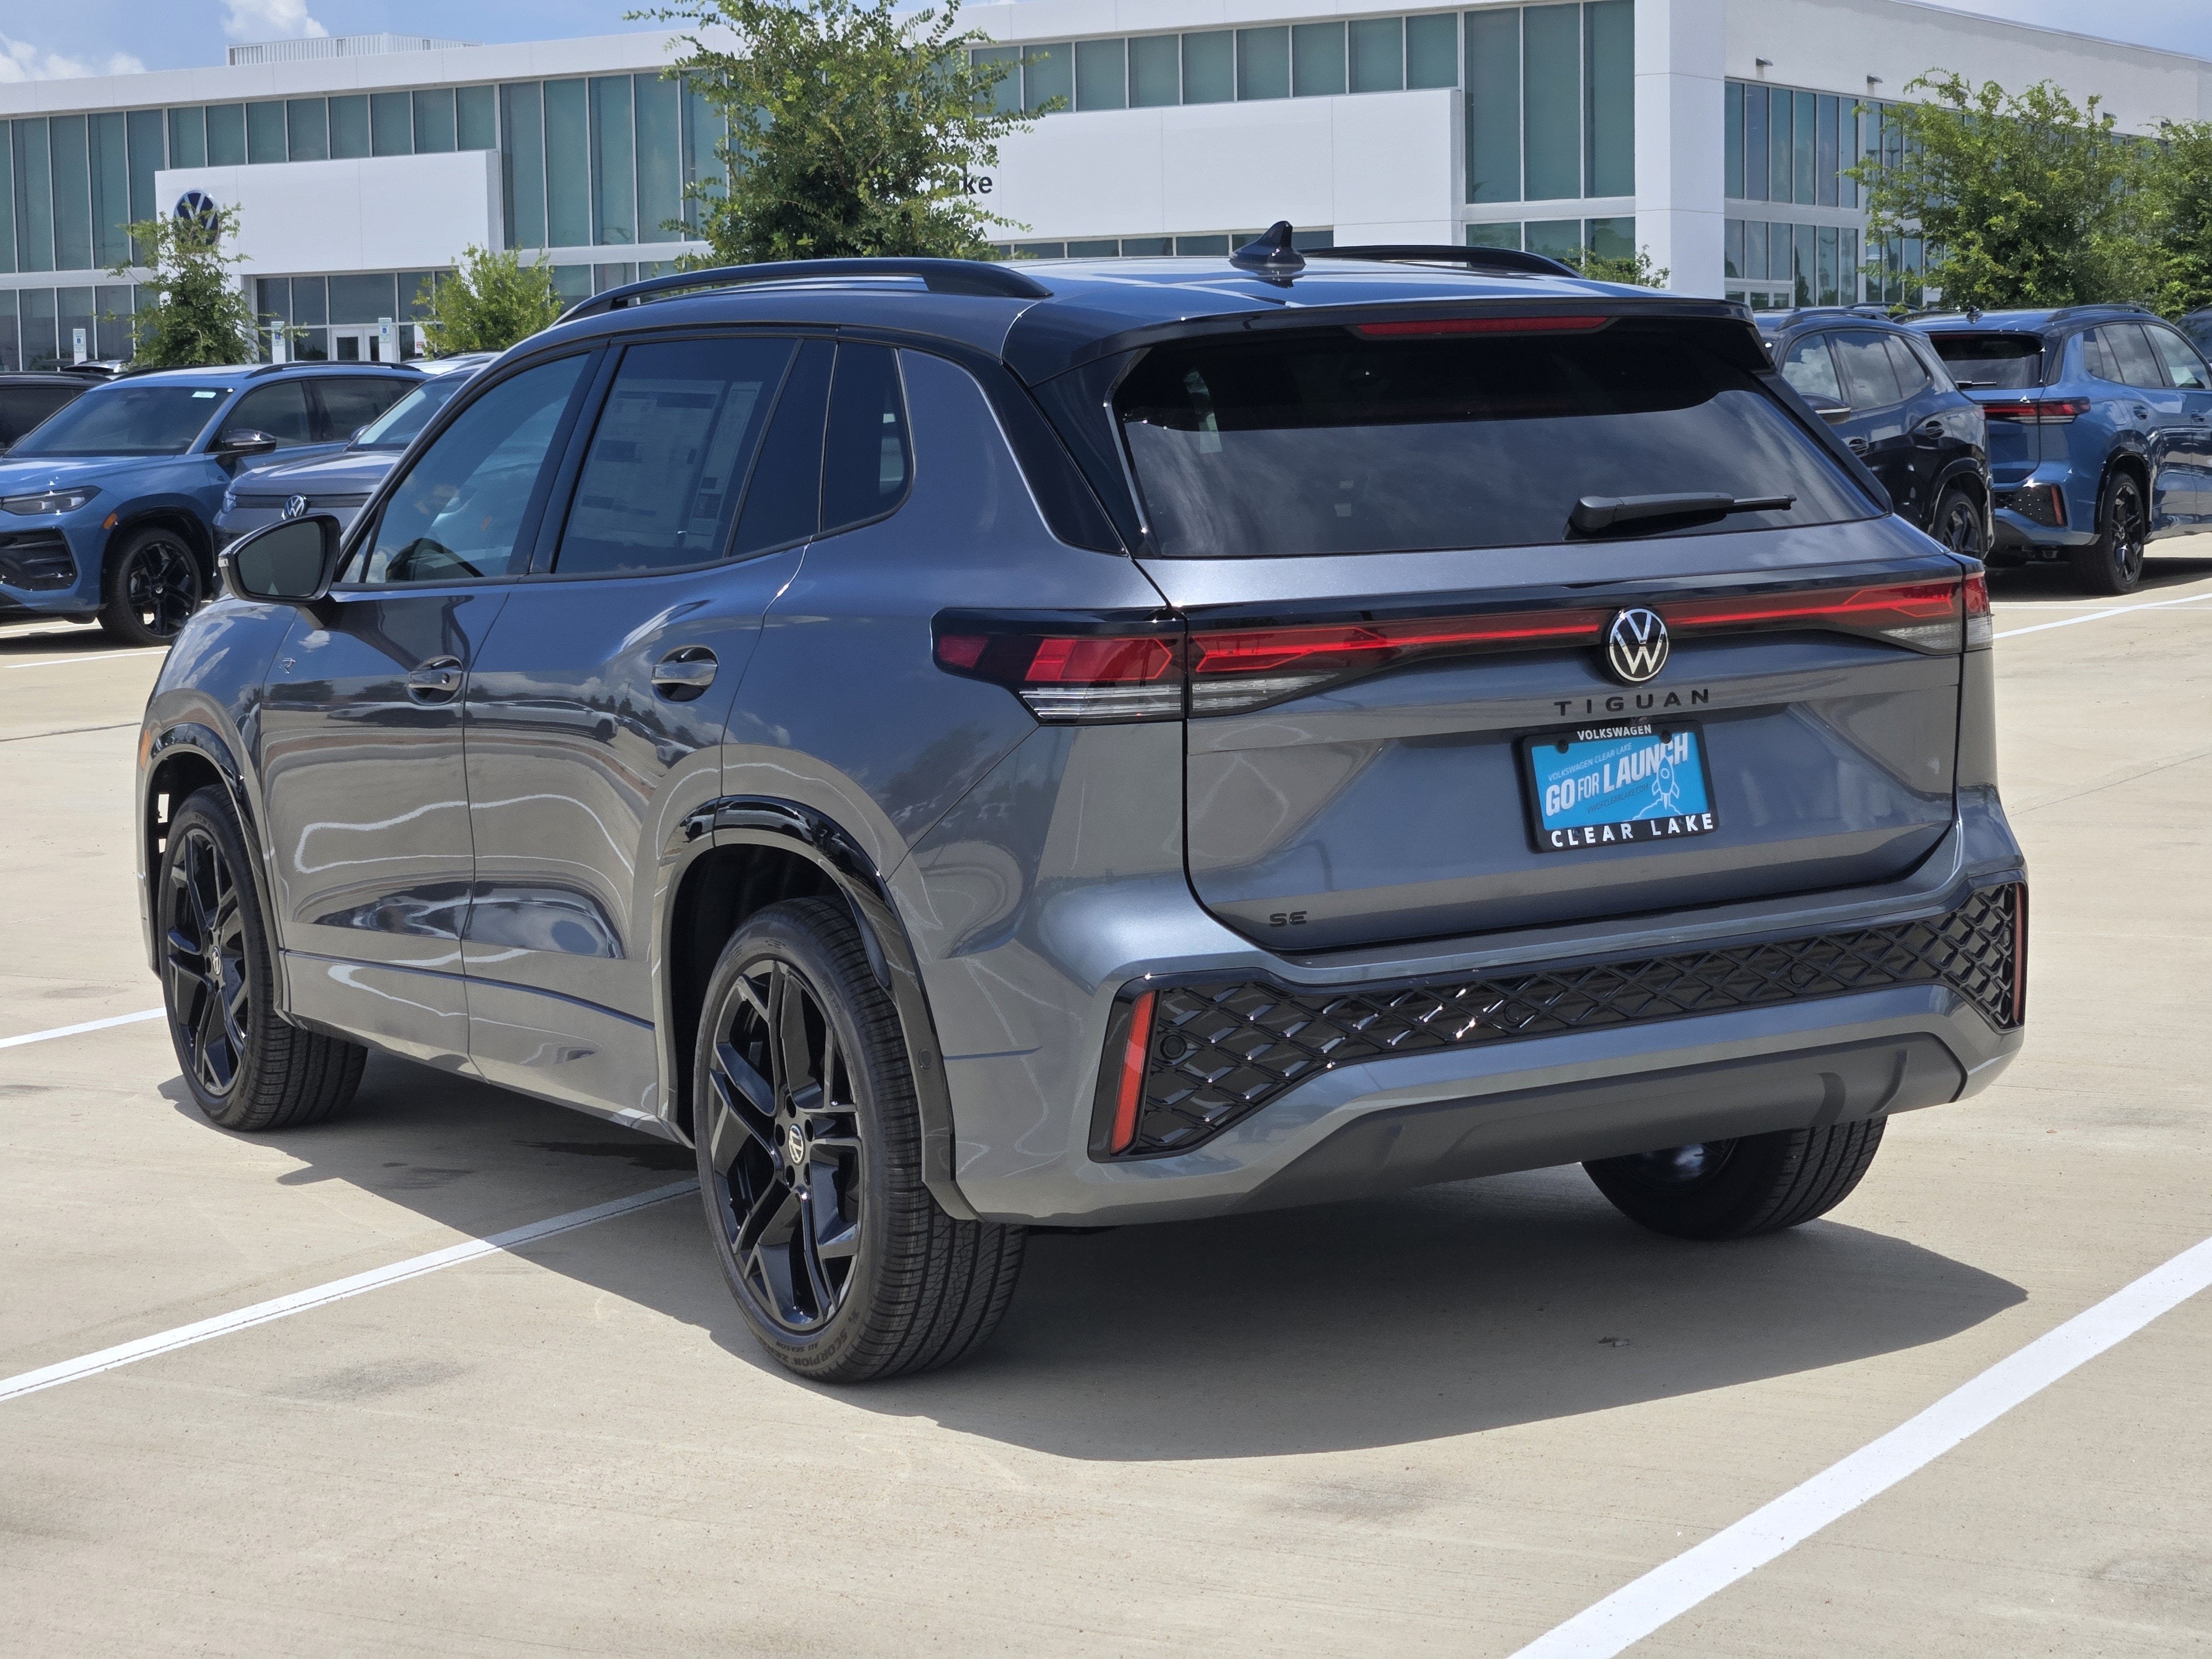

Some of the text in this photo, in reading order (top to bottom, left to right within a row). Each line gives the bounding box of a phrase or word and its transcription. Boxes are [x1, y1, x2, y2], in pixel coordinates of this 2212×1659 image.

[1611, 610, 1668, 678] VW
[1553, 688, 1709, 717] TIGUAN
[1577, 724, 1652, 740] VOLKSWAGEN
[1546, 732, 1688, 817] GO FOR LAUNCH
[1548, 742, 1632, 782] VOLKSWAGEN CLEAR LAKE
[1587, 783, 1649, 814] VWOFCLEARLAKE.COM
[1551, 813, 1714, 848] CLEAR LAKE
[1270, 910, 1307, 927] SE
[775, 1340, 819, 1353] ALL SEASON
[793, 1328, 848, 1368] SCORPION
